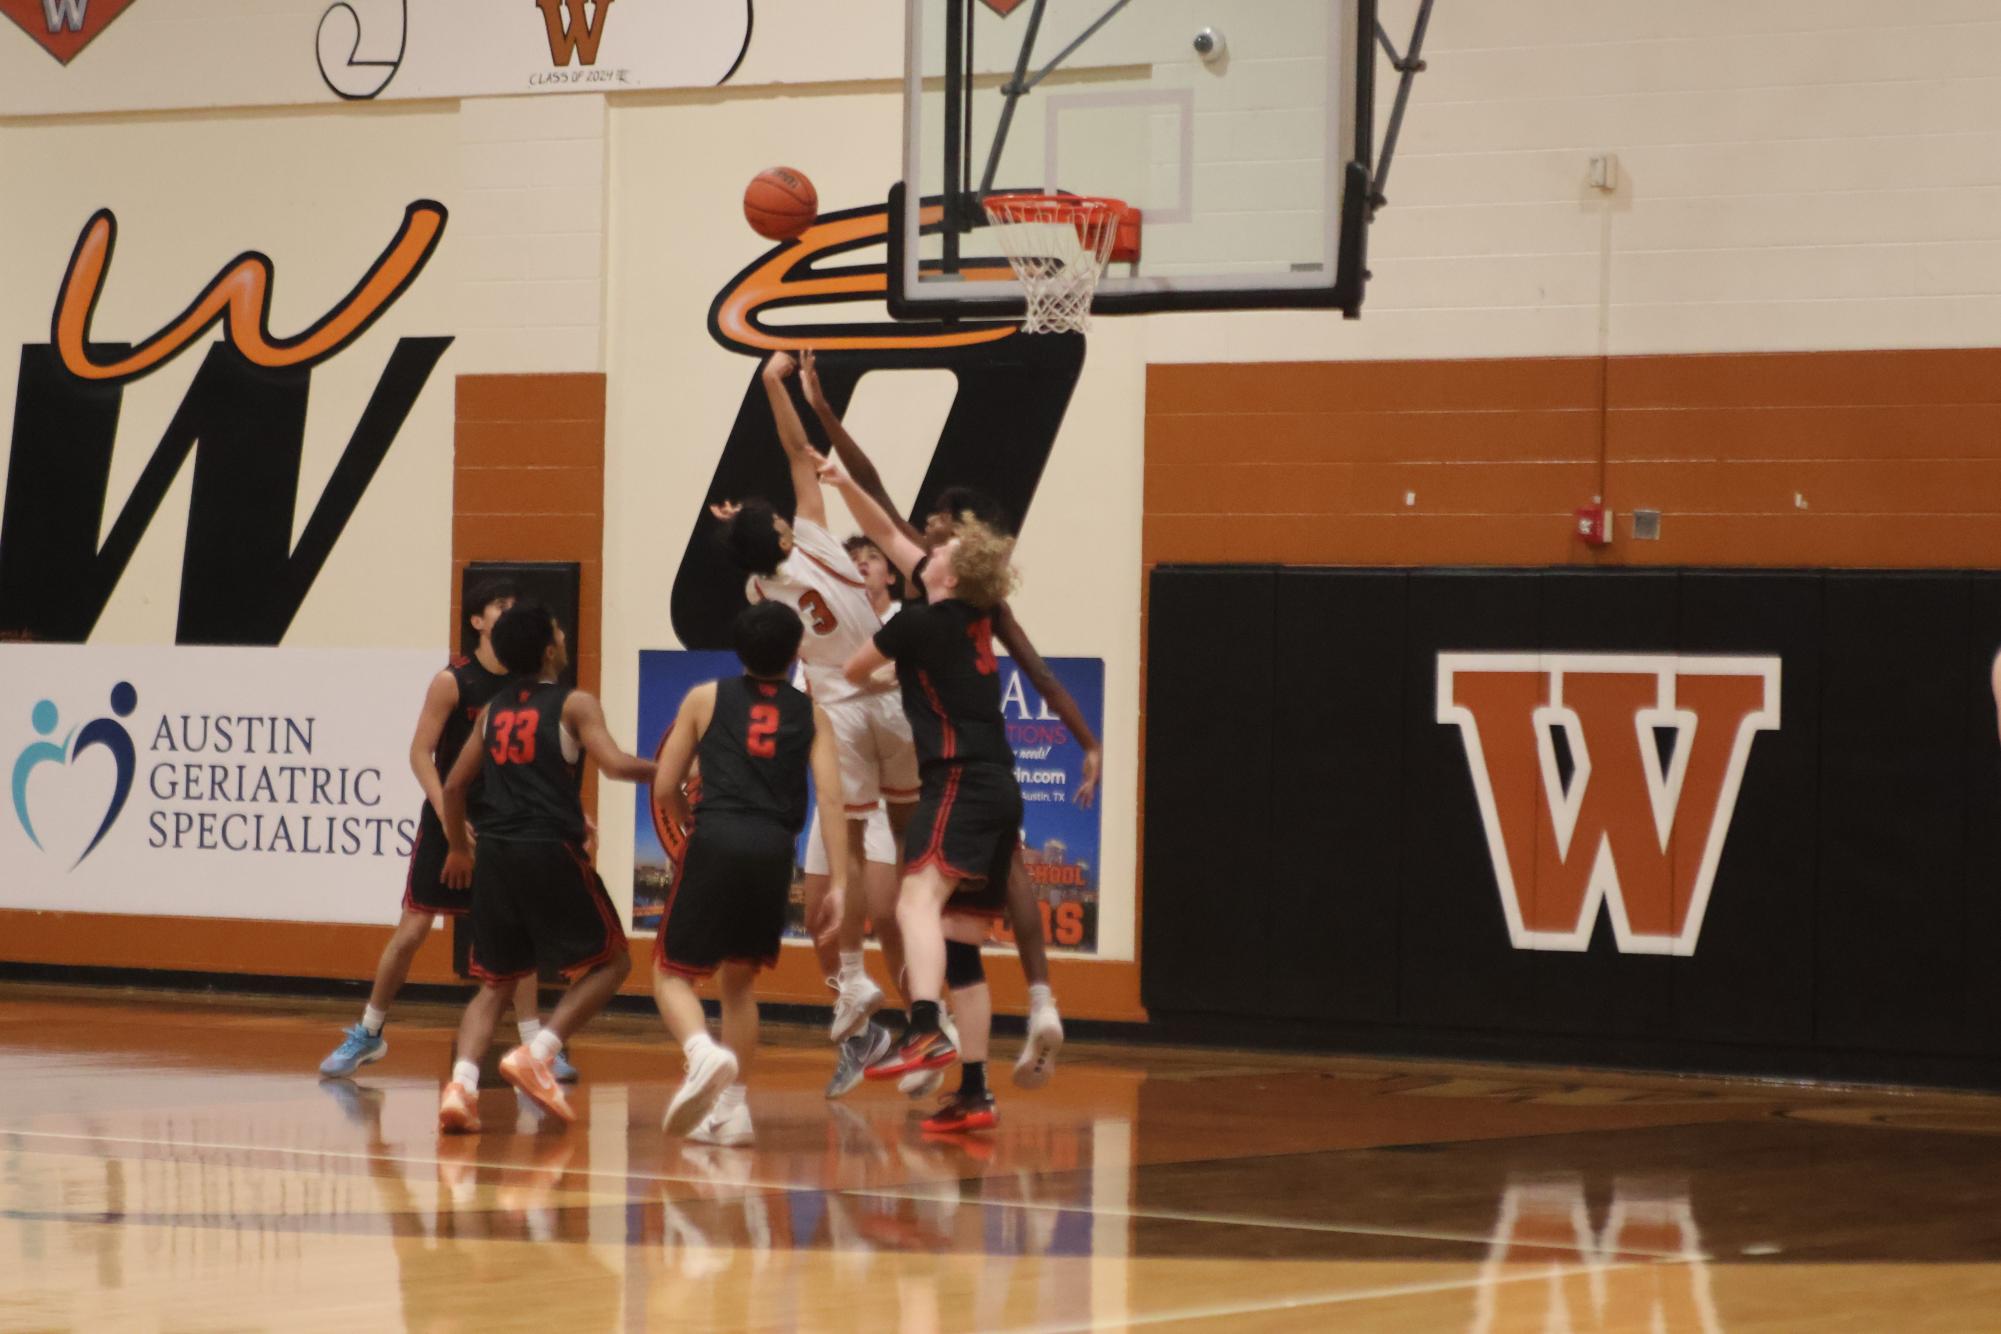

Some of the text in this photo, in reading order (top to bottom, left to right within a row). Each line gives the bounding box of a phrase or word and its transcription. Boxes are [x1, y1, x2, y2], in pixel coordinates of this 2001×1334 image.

[42, 0, 89, 33] W
[535, 0, 615, 67] W
[528, 71, 569, 87] CLASS
[571, 70, 584, 83] OF
[586, 69, 614, 83] 2024
[797, 589, 839, 636] 3
[150, 714, 316, 755] AUSTIN
[489, 707, 541, 766] 33
[746, 704, 780, 759] 2
[149, 763, 382, 807] GERIATRIC
[1435, 650, 1782, 957] W
[148, 811, 418, 858] SPECIALISTS
